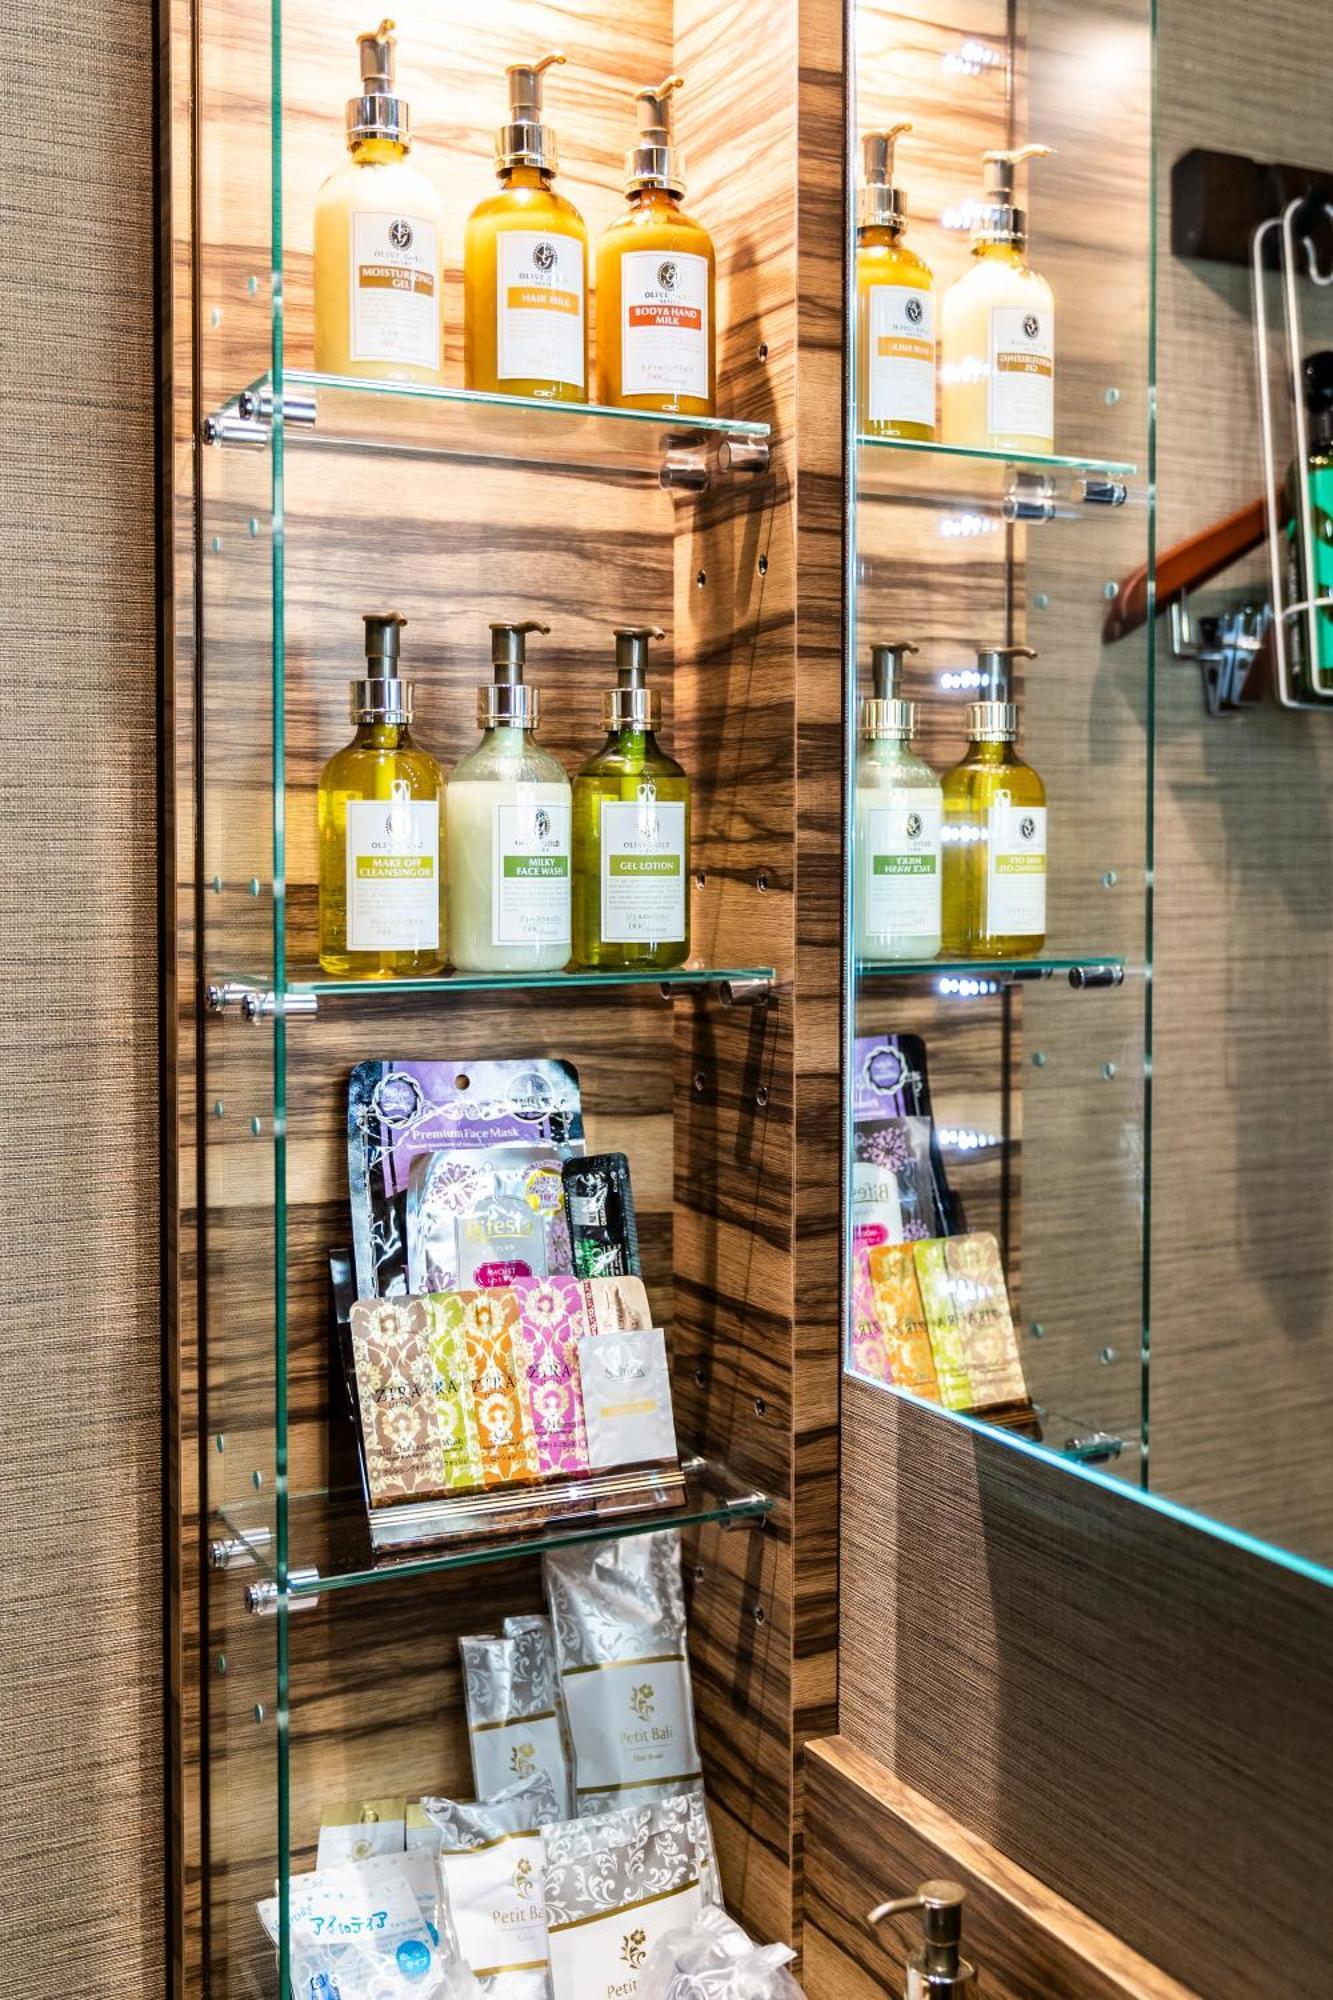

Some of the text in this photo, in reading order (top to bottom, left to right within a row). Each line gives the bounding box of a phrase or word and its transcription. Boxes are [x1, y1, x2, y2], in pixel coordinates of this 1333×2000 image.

[361, 267, 433, 287] MOISTURZING
[392, 279, 411, 289] GEL
[522, 293, 547, 304] HAIR
[671, 308, 697, 319] HAND
[656, 316, 680, 325] MILK
[373, 859, 401, 868] MAKE
[528, 858, 555, 867] MILKY
[620, 862, 674, 871] GEL LOTION
[359, 868, 416, 877] CLEANSING
[517, 868, 563, 876] FACE WASH
[412, 1126, 519, 1140] Premium Face Mask
[528, 1363, 572, 1378] ZIRA
[471, 1375, 516, 1393] ZIRA
[374, 1384, 421, 1402] ZIRA
[651, 1726, 673, 1740] Bali
[492, 1907, 526, 1924] Petit
[607, 1978, 638, 1999] Petit
